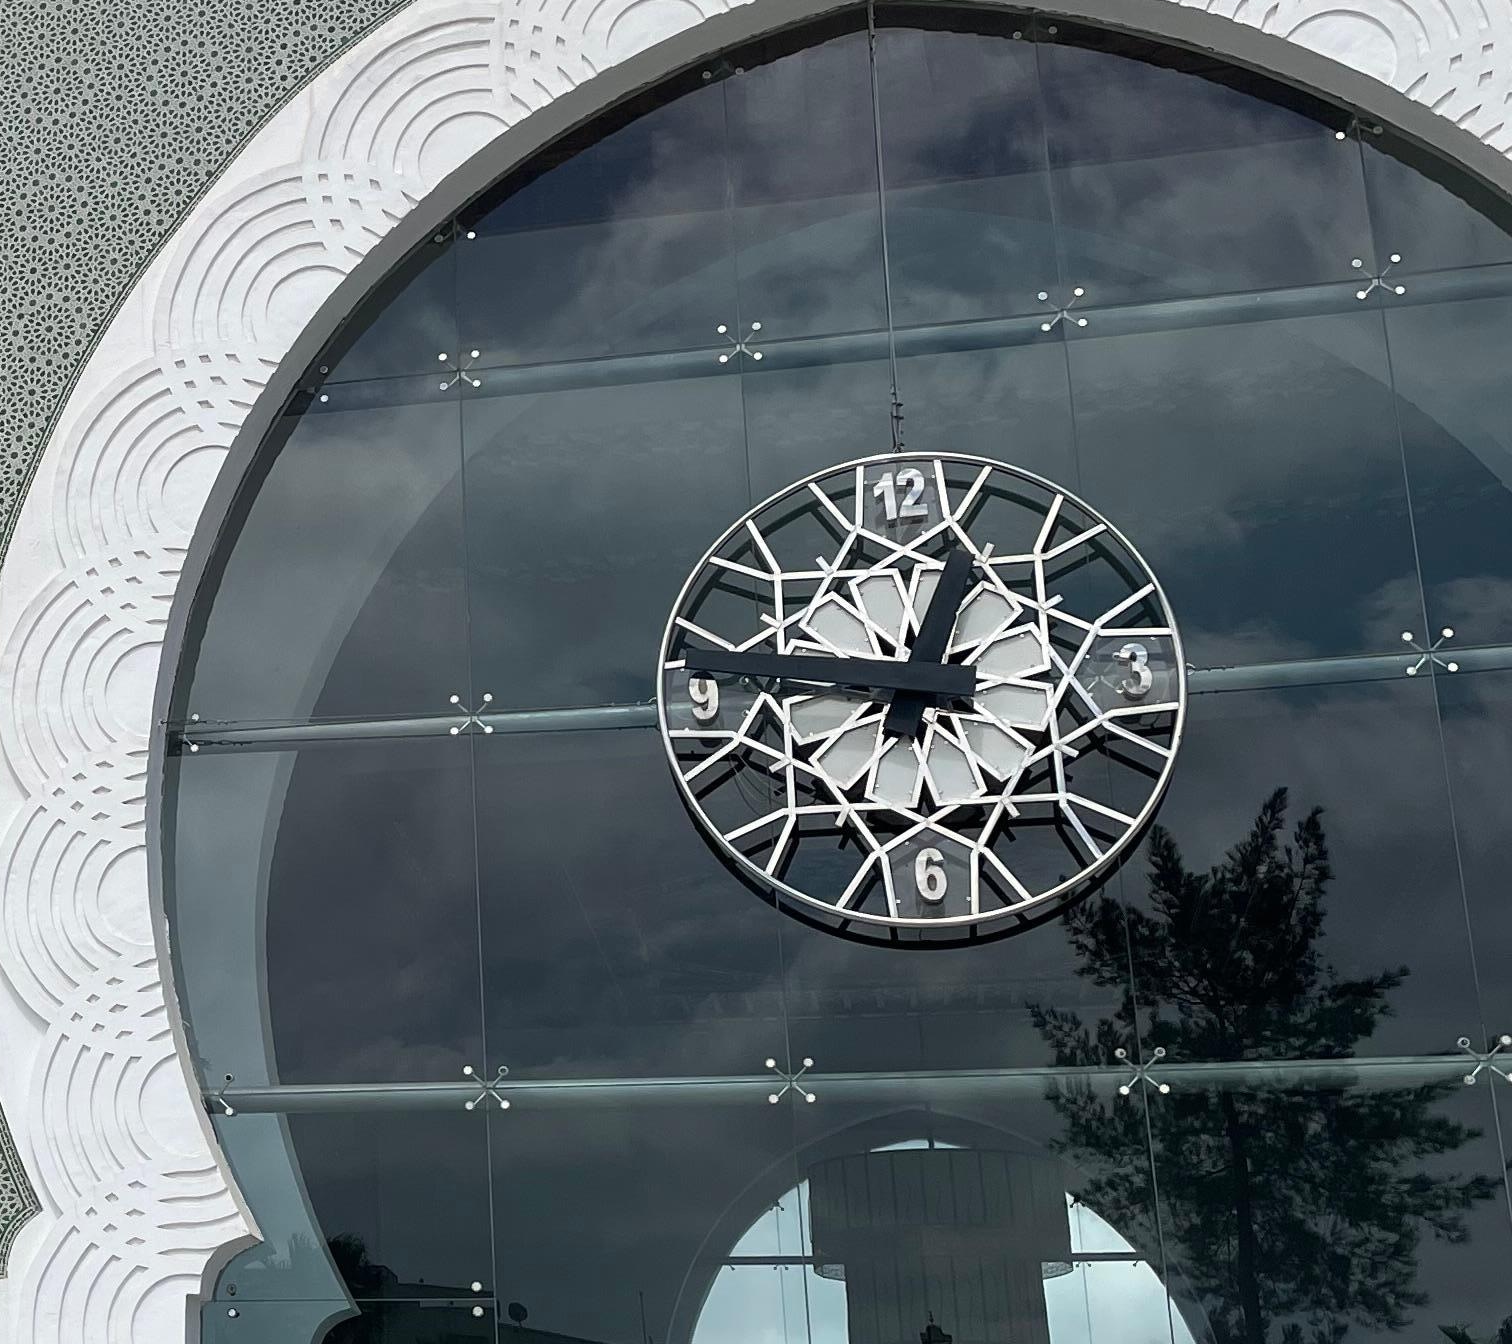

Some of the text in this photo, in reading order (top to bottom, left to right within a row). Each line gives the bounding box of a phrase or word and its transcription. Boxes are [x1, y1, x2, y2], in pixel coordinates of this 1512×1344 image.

[872, 468, 928, 521] 12
[688, 668, 720, 727] 9
[1112, 642, 1153, 699] 3
[913, 847, 948, 904] 6
